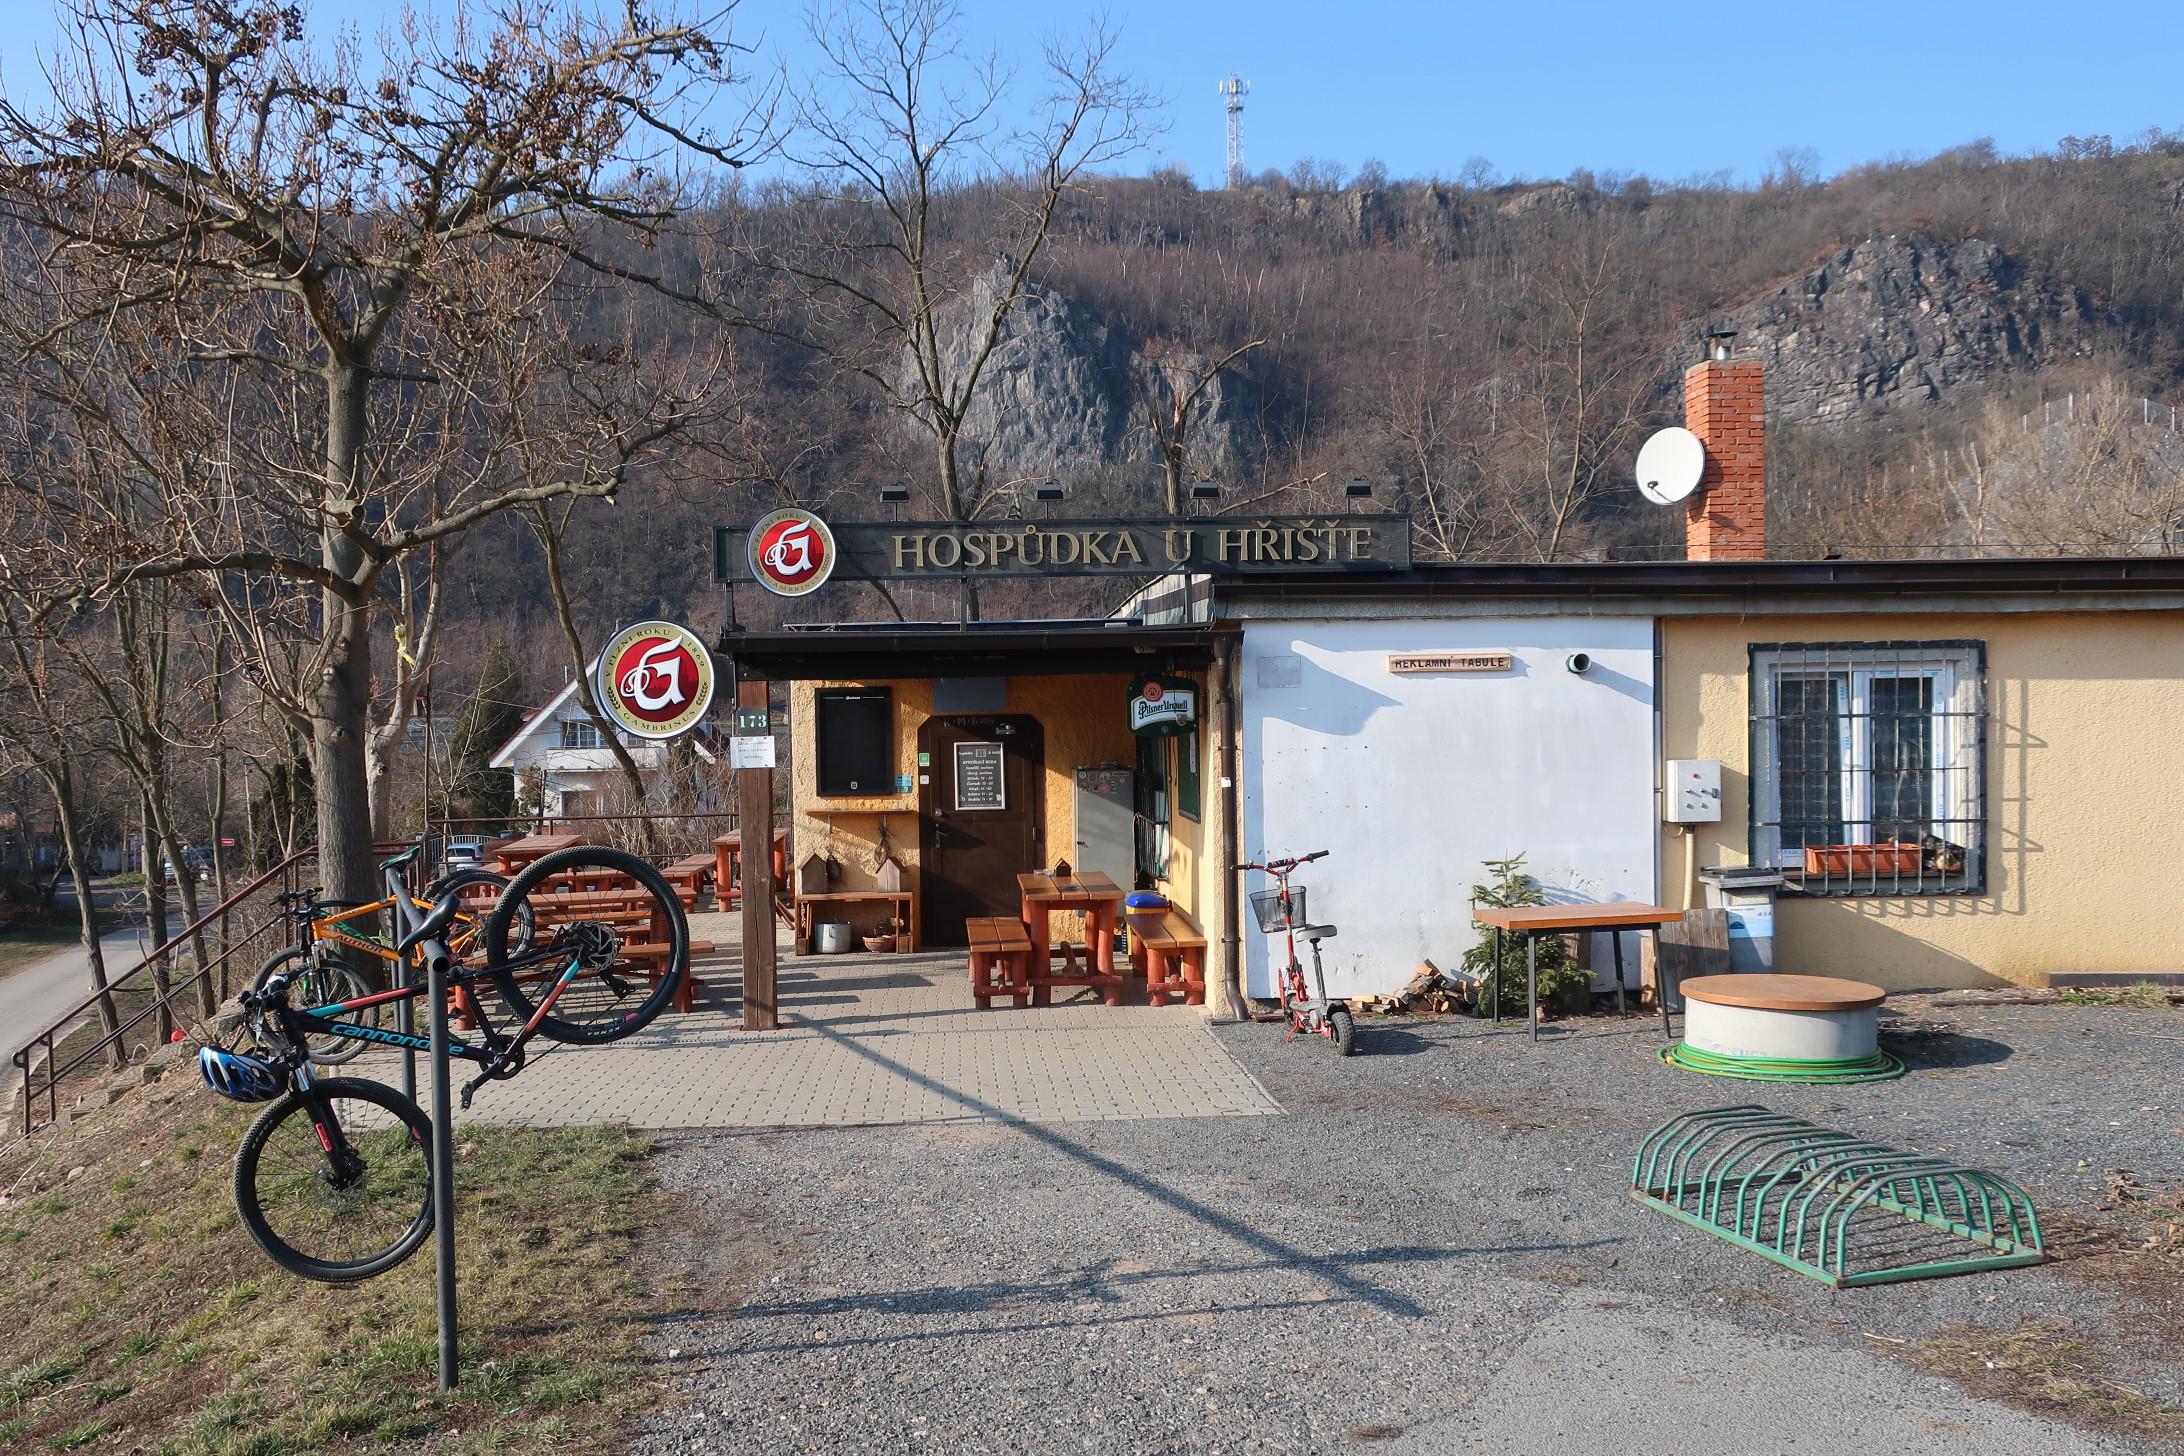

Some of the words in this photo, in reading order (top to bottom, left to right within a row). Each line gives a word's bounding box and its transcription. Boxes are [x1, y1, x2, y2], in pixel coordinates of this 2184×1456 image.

[891, 524, 1143, 568] HOSPŮDKA
[1162, 529, 1195, 562] U
[609, 636, 634, 667] PLZNI
[636, 628, 671, 638] ROKU
[687, 641, 705, 667] 1869
[1461, 657, 1505, 667] TABULE
[1138, 700, 1164, 720] Pilsner
[1163, 700, 1188, 712] Urquell
[623, 710, 695, 731] GAMBRINUS
[739, 715, 767, 728] 173
[336, 934, 384, 954] AUTHOR
